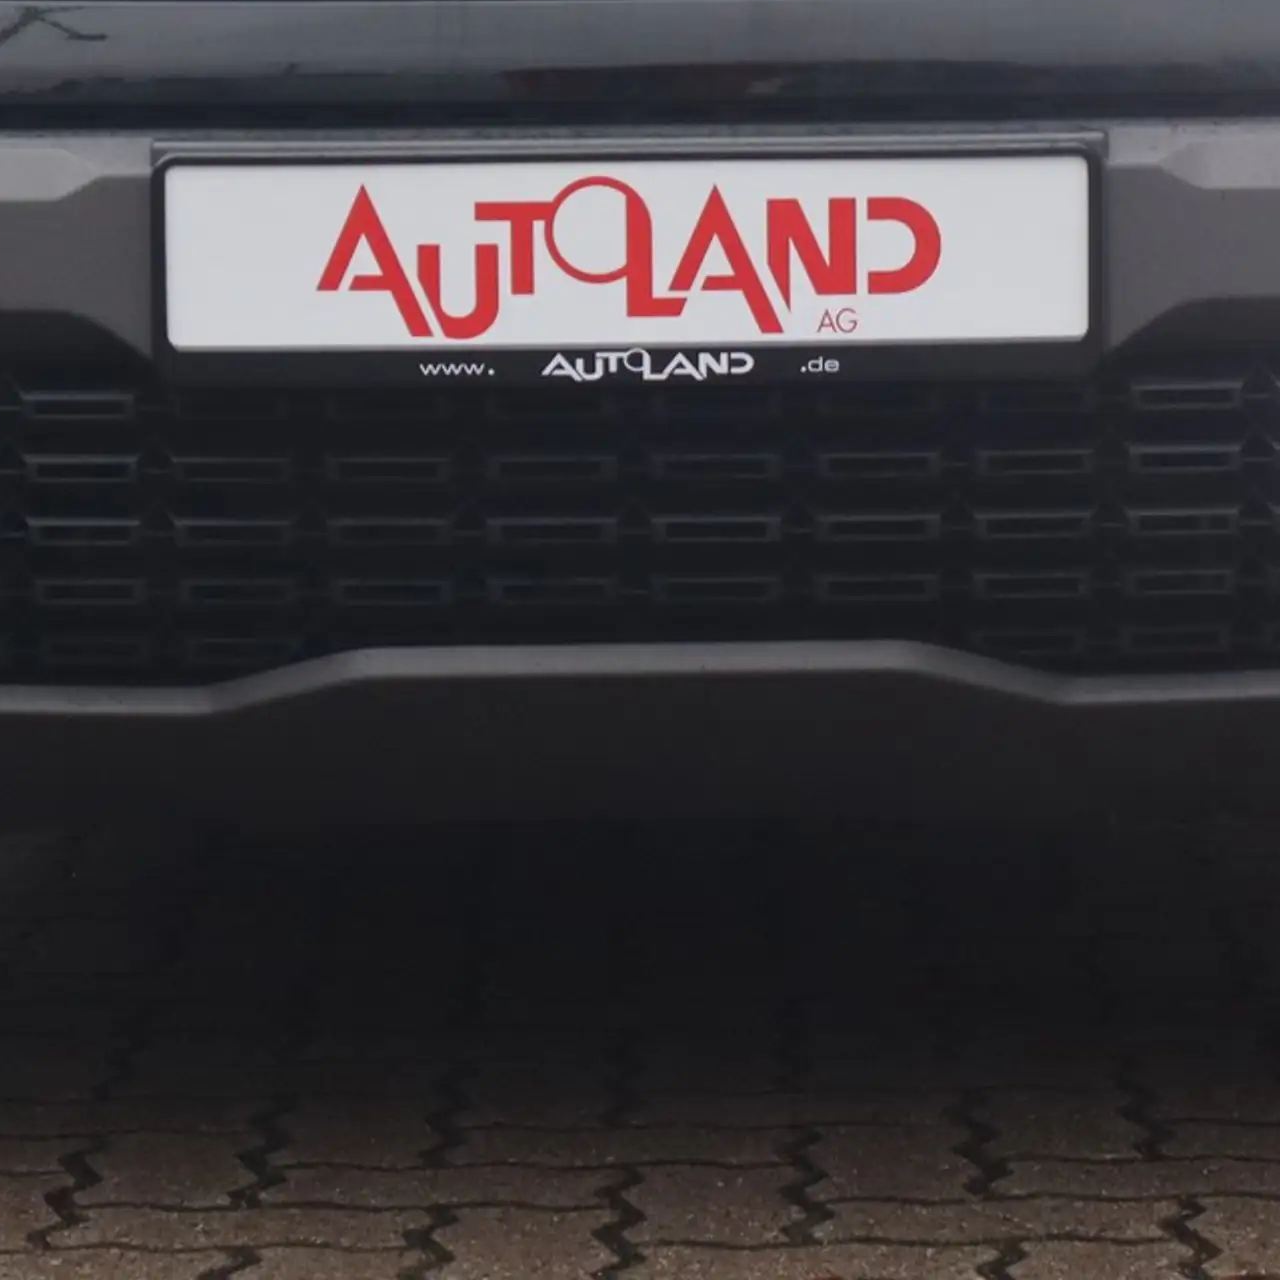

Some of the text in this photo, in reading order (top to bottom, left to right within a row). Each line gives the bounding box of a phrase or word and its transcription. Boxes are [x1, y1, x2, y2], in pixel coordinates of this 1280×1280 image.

[816, 307, 859, 335] AG
[419, 362, 496, 377] www.
[799, 355, 841, 374] .de
